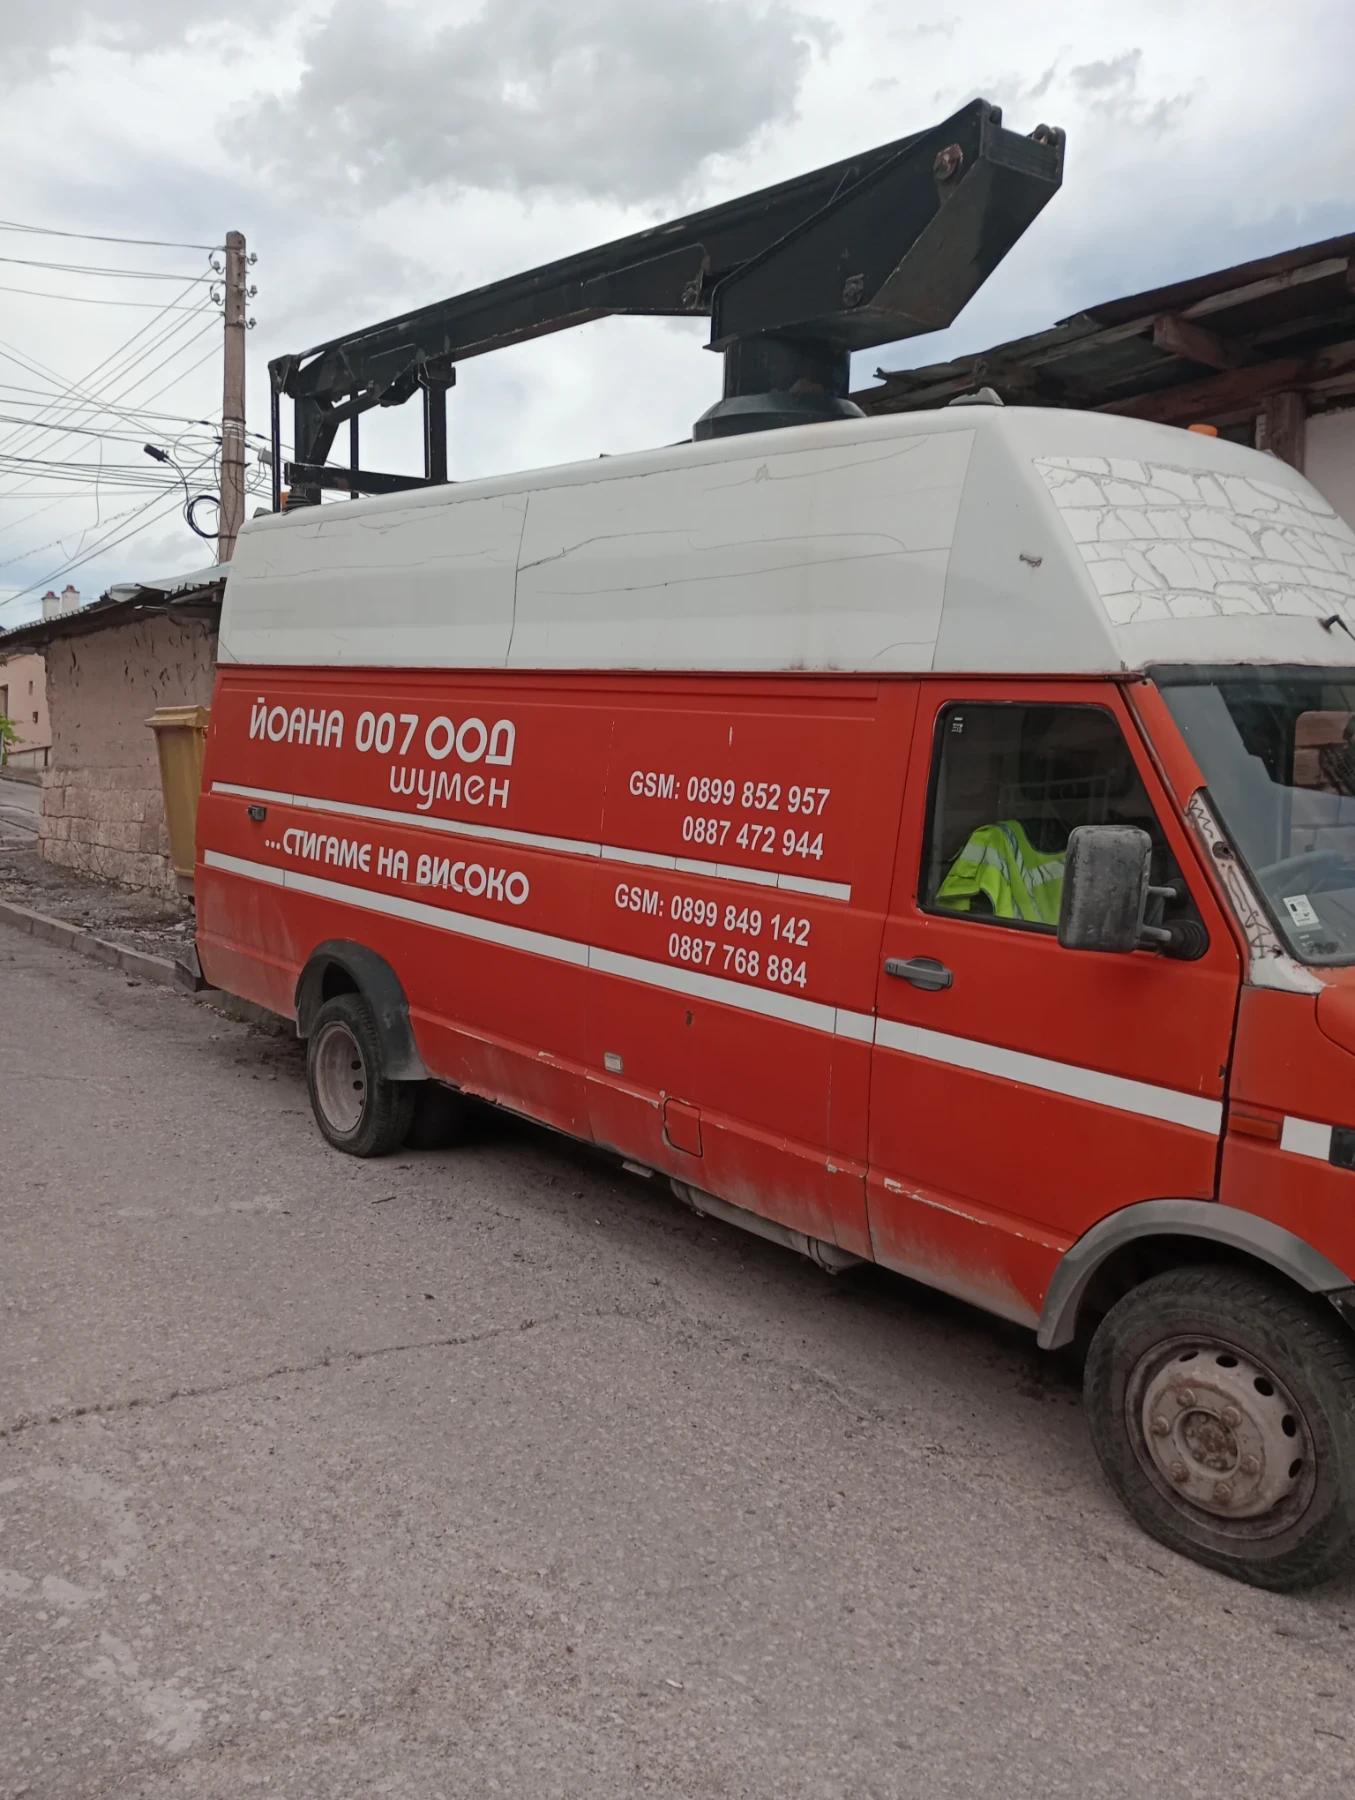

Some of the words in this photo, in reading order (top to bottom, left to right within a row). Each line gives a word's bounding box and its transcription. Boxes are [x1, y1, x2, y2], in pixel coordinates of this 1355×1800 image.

[249, 696, 345, 748] ЙОАНА
[355, 710, 419, 756] 007
[424, 715, 517, 766] ООД
[629, 770, 681, 801] GSM:
[686, 776, 736, 806] 0899
[741, 781, 782, 811] 852
[787, 785, 831, 816] 957
[682, 815, 732, 846] 0887
[735, 822, 776, 854] 472
[782, 828, 824, 861] 944
[377, 846, 409, 881] НА
[415, 854, 530, 905] ВИСОКО
[614, 883, 665, 917] GSM:
[670, 895, 718, 928] 0899
[723, 904, 763, 937] 849
[770, 913, 811, 947] 142
[668, 932, 717, 966] 0887
[722, 944, 760, 977] 768
[766, 954, 807, 988] 884
